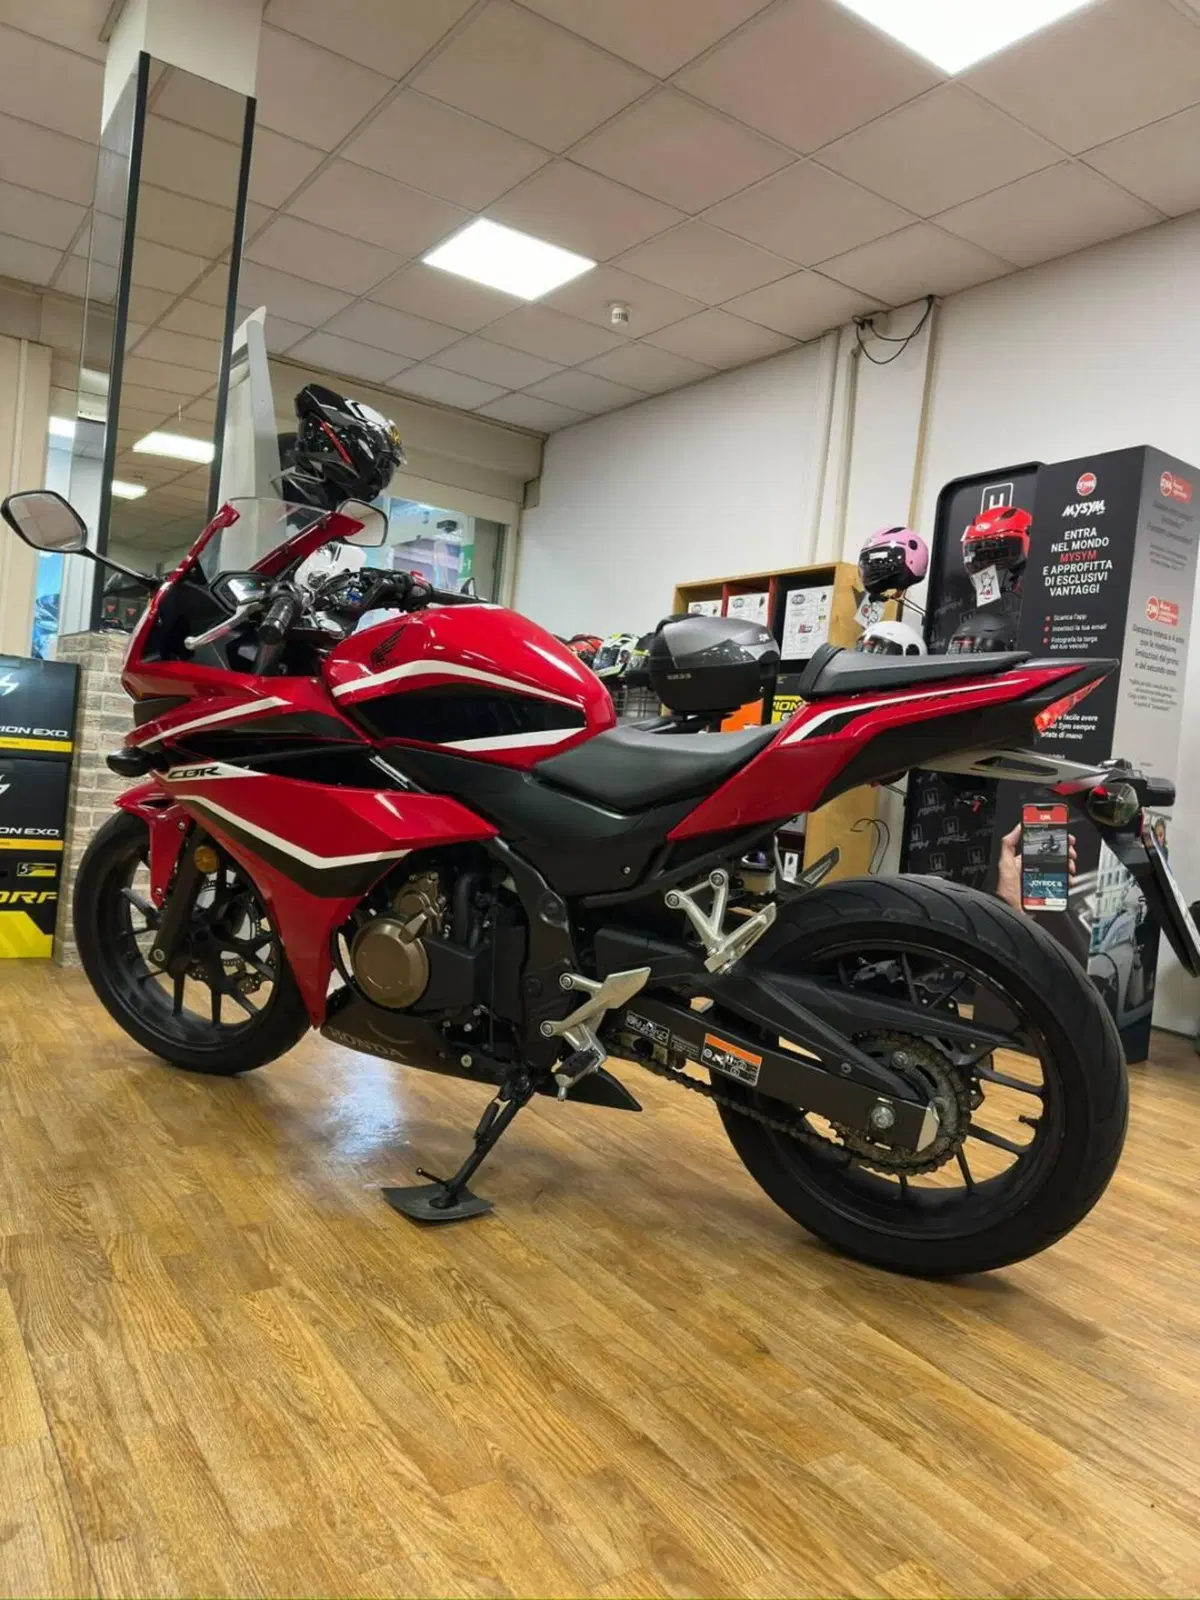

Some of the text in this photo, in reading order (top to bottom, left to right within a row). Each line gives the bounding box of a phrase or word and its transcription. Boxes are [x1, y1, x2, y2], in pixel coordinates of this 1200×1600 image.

[1061, 500, 1106, 518] MYSYM
[1064, 527, 1097, 541] ENTRA
[1050, 537, 1109, 553] NEL MONDO
[1060, 550, 1097, 563] MYSYM
[1042, 560, 1113, 576] E APPROFITTA
[1044, 571, 1108, 587] DI ESCLUSIVI
[1049, 584, 1100, 597] VANTAGGI
[0, 725, 69, 738] ION EXO
[1058, 722, 1072, 731] Sym
[168, 766, 222, 779] CBR
[24, 828, 60, 836] EXO
